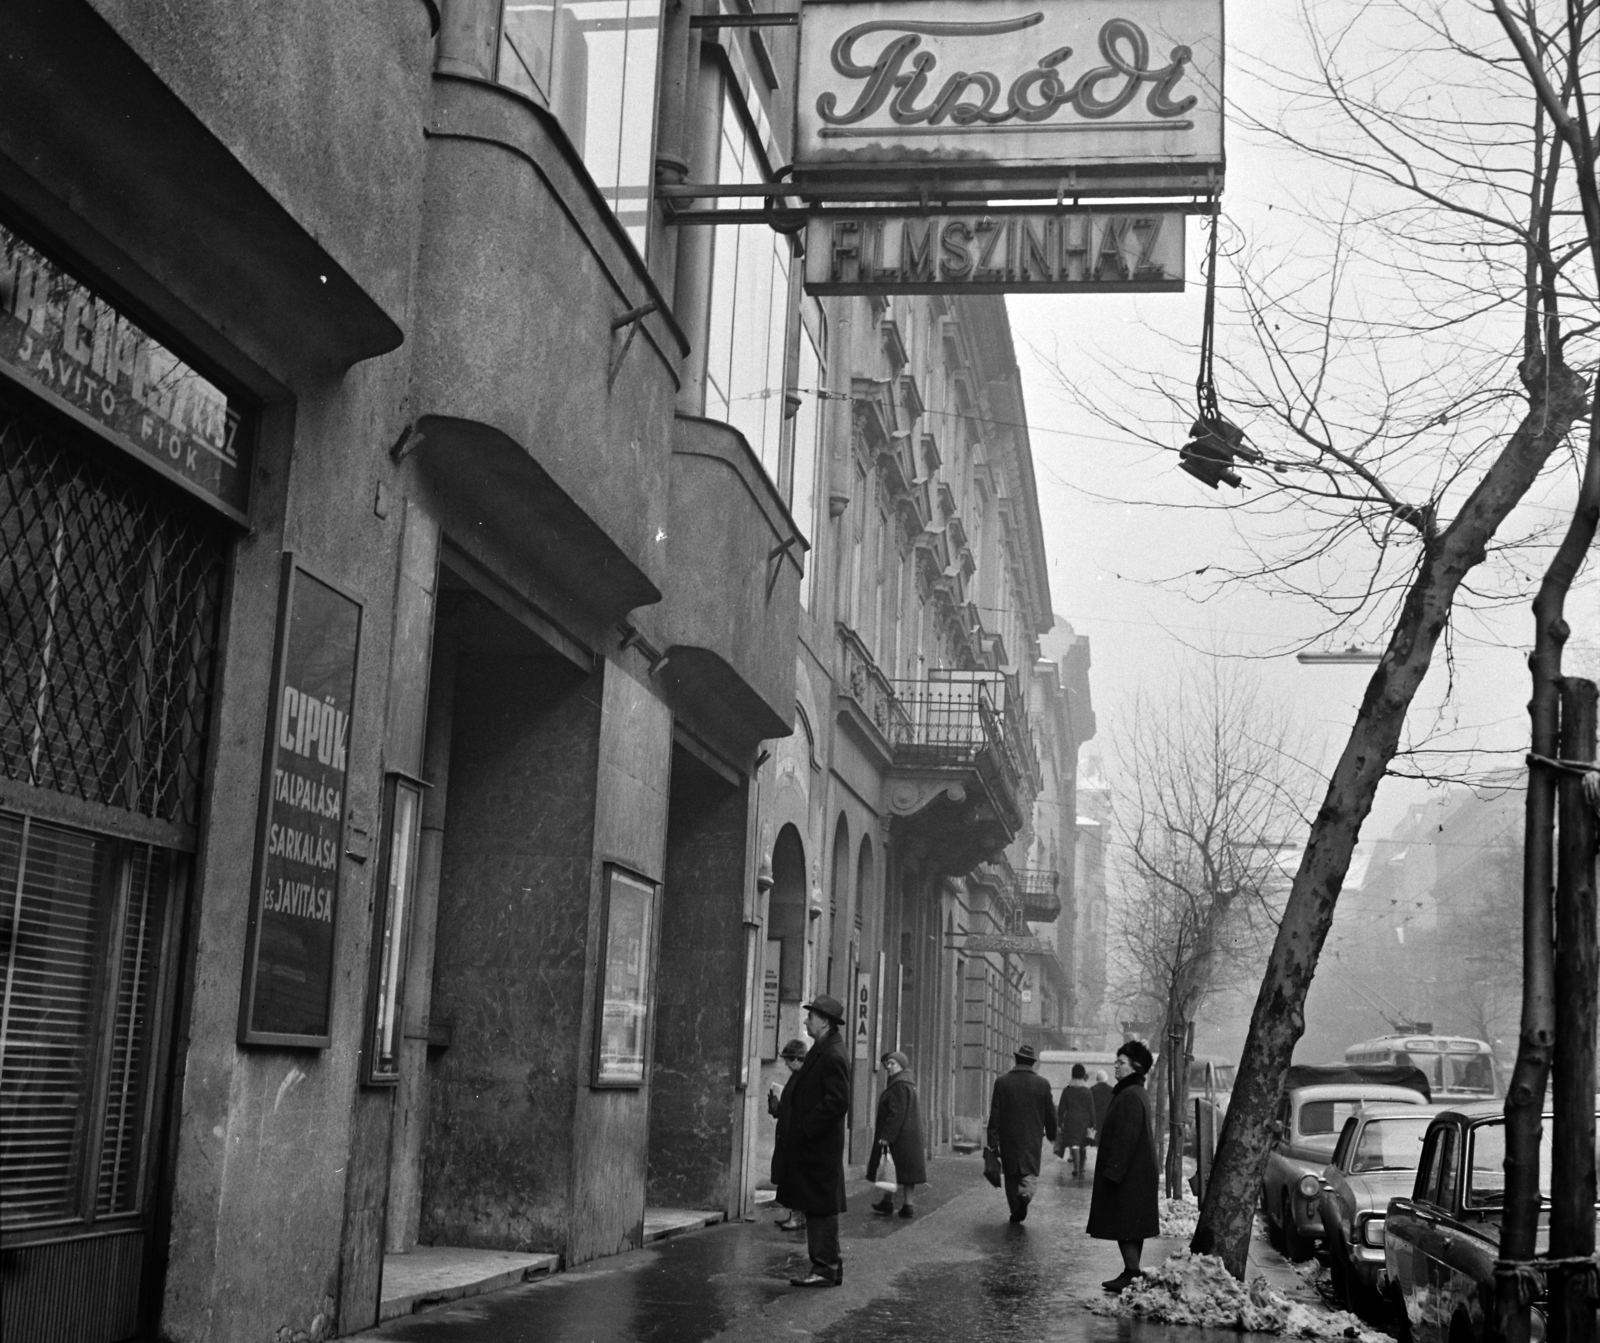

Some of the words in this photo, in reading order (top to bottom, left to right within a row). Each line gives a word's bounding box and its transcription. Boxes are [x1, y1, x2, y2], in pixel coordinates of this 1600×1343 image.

[141, 415, 198, 471] FIÓK
[275, 768, 340, 821] TALPALÁSA
[269, 823, 337, 871] SARKALÁSA
[858, 985, 868, 1036] ÓRA
